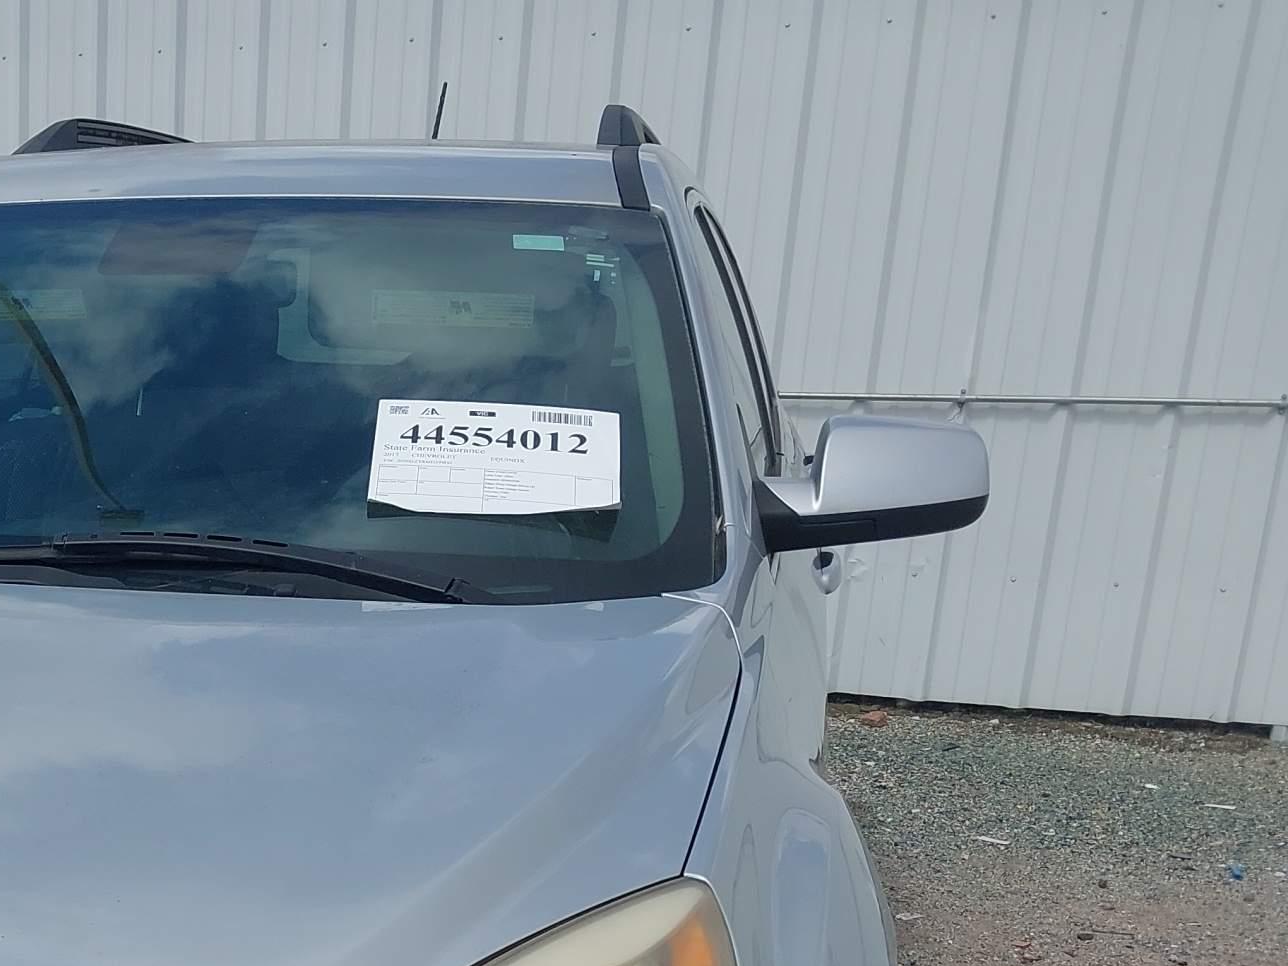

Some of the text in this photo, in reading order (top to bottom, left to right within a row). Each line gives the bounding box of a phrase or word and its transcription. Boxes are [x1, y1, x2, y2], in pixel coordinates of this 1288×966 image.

[399, 424, 589, 454] 44554012
[383, 444, 486, 455] State Farm Insurance
